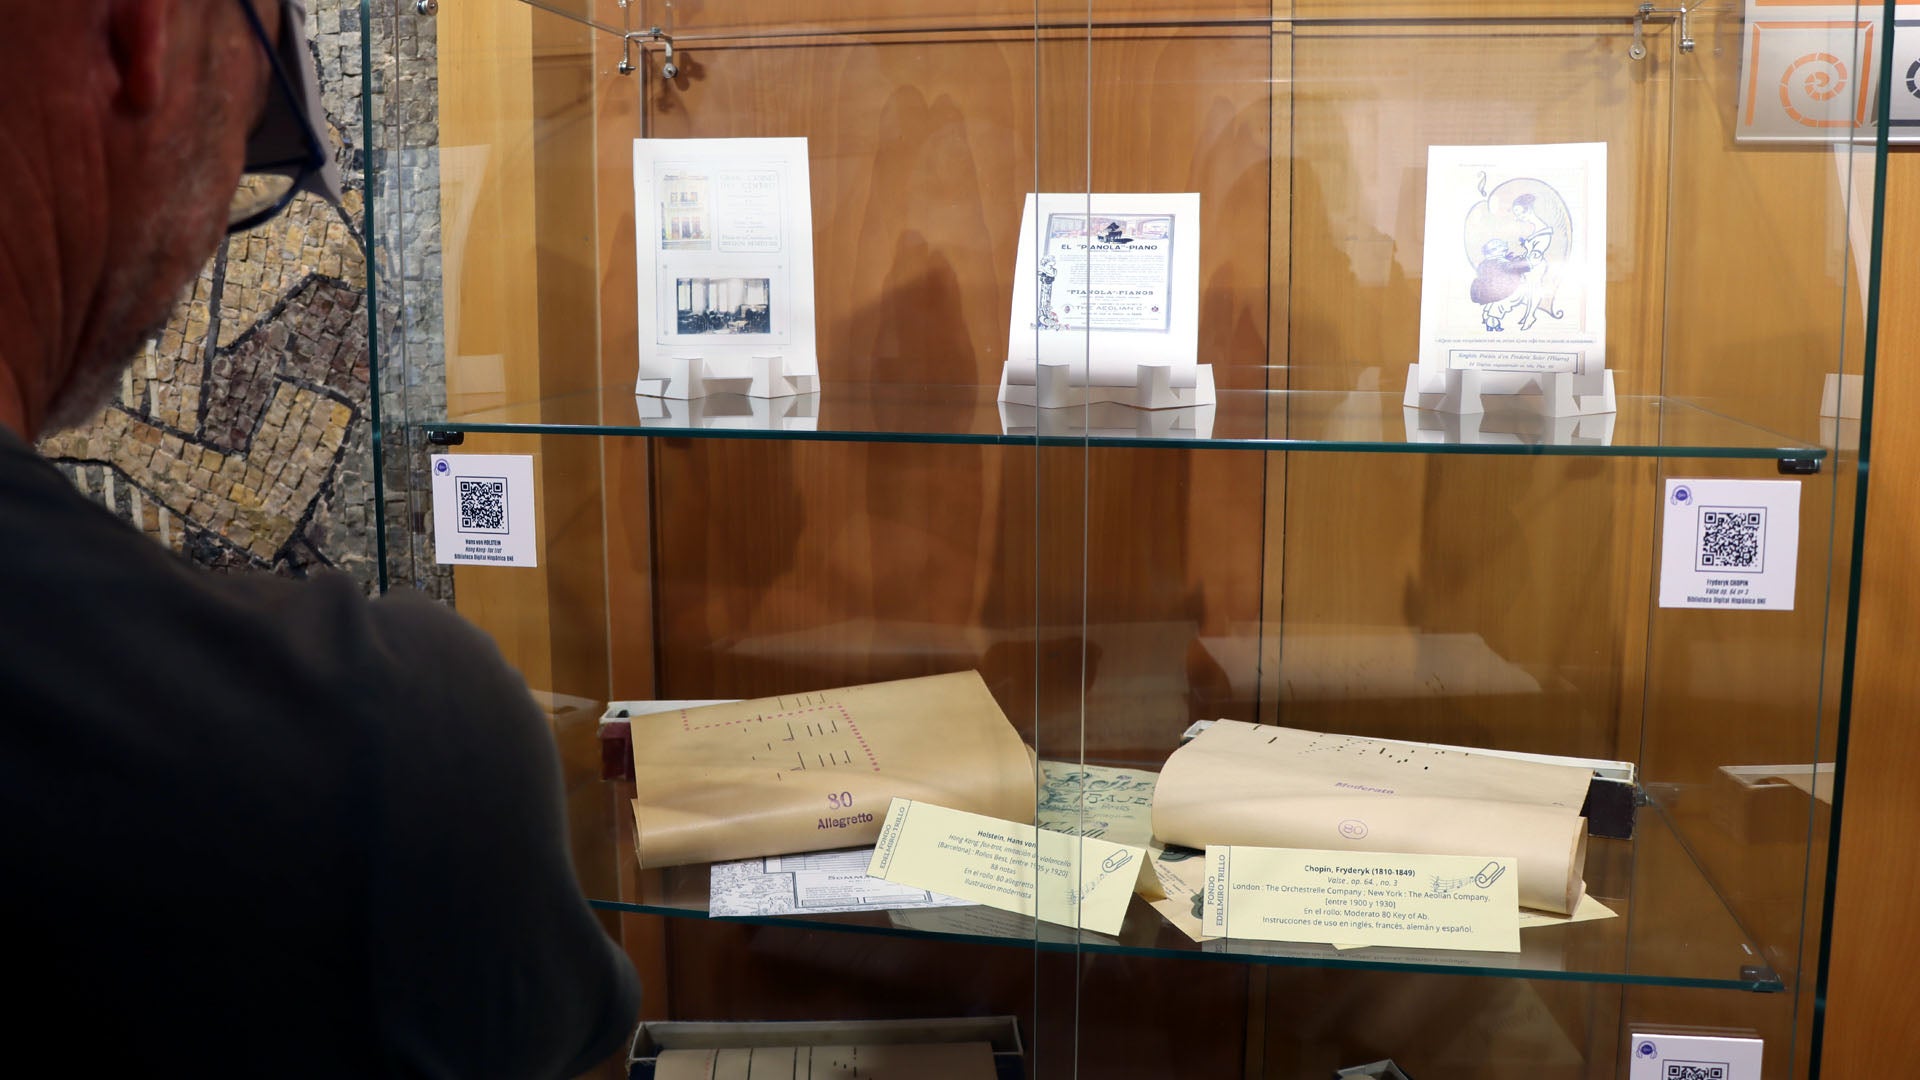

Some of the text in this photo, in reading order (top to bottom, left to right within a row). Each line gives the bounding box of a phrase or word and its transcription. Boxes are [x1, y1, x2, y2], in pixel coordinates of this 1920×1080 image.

[1706, 579, 1729, 587] Fryderyk
[1713, 596, 1730, 604] Digital
[1334, 782, 1395, 795] Moderato
[827, 791, 853, 810] 80
[817, 812, 874, 831] Allegretto
[1343, 823, 1364, 835] 80
[879, 824, 892, 850] FONDO
[880, 806, 905, 869] EDELMIRO TRILLO
[1007, 836, 1023, 846] Hans
[1024, 841, 1037, 849] von
[948, 834, 964, 844] Hong
[1004, 846, 1031, 857] imitación
[1040, 855, 1072, 867] violoncello
[975, 849, 993, 860] Rollos
[964, 867, 973, 875] En
[1004, 877, 1034, 889] allegretto
[999, 866, 1016, 875] notas
[1304, 864, 1416, 877] Chopin, Fryderyk (1810-1849)
[1327, 876, 1346, 884] Valse
[964, 878, 1032, 899] Ilustración modernista
[1207, 876, 1215, 905] FONDO
[1216, 854, 1226, 926] EDELMIRO TRILLO
[1232, 882, 1260, 891] London
[1266, 884, 1280, 892] The
[1281, 885, 1325, 894] Orchestrelle
[1326, 887, 1362, 897] Company
[1367, 889, 1384, 897] New
[1423, 891, 1451, 899] Aeolian
[1376, 900, 1396, 909] 1930]
[1343, 910, 1380, 918] Moderato
[1393, 911, 1406, 920] Key
[1417, 912, 1430, 920] Ab.
[1262, 916, 1311, 925] Instrucciones
[1406, 923, 1434, 931] alemán
[1442, 924, 1474, 933] español.
